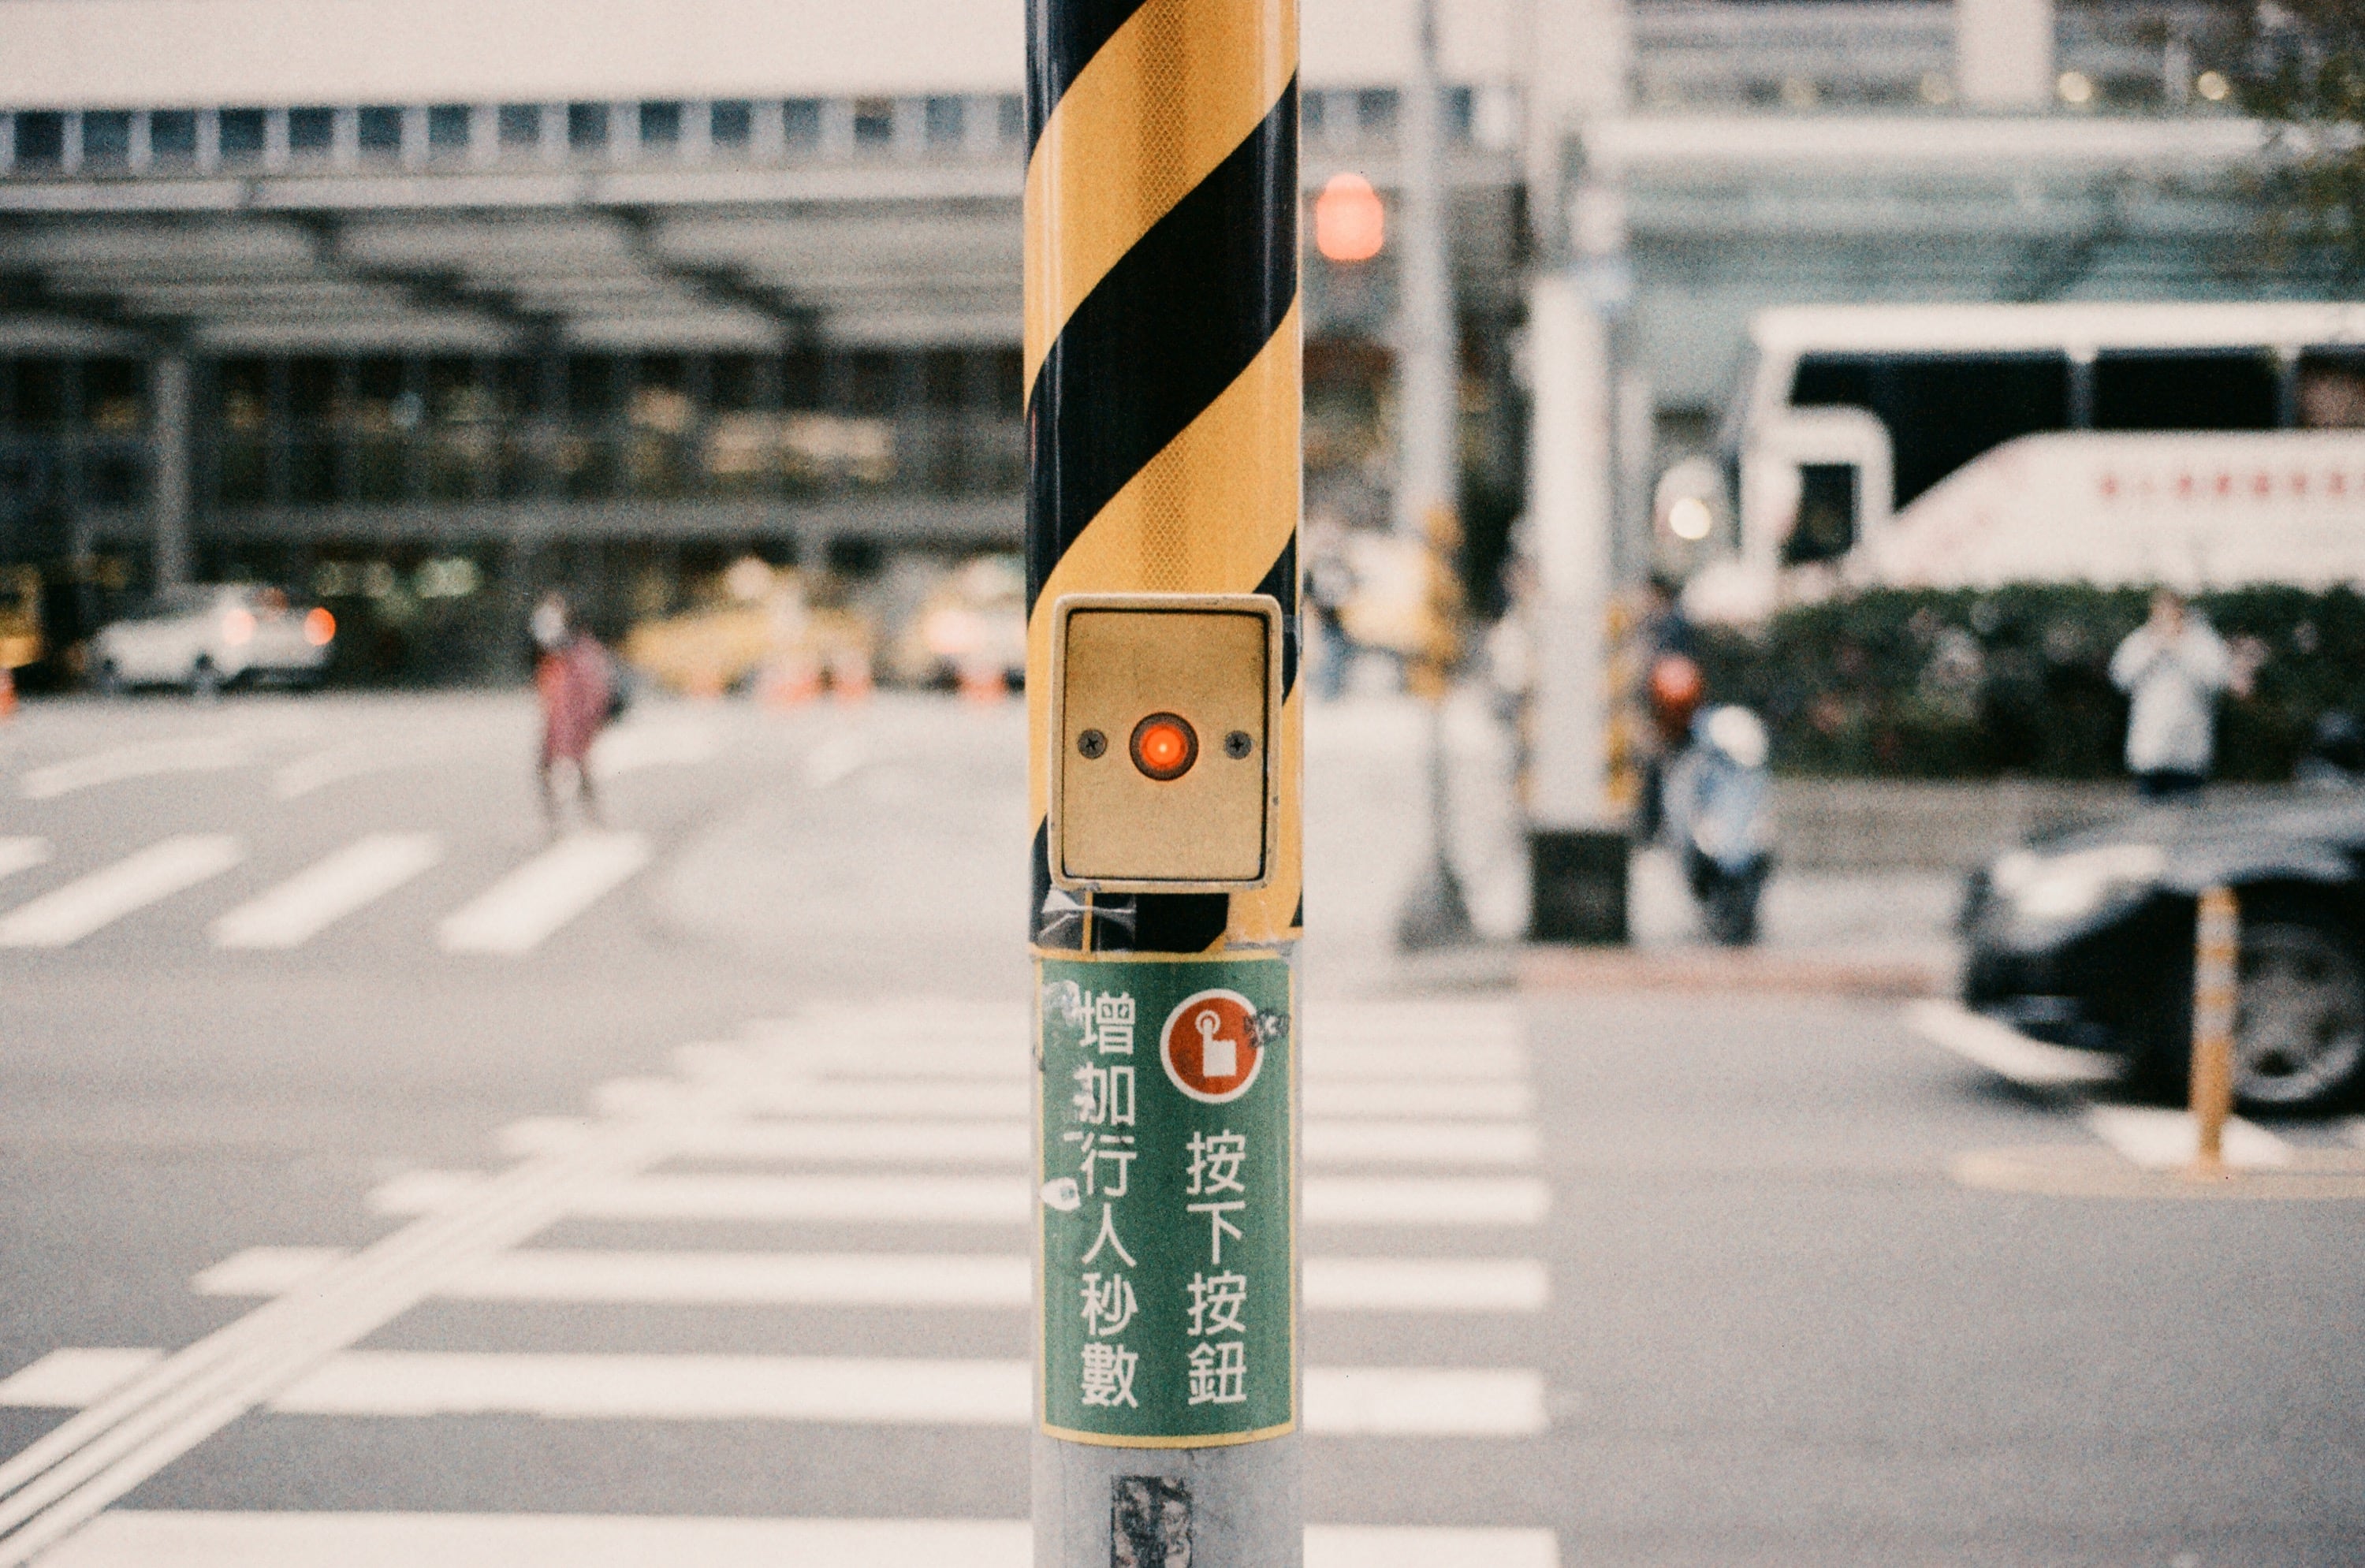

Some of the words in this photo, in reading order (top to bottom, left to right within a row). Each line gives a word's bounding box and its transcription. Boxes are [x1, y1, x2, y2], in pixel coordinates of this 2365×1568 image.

[1074, 991, 1138, 1409] 增加行人秒數
[1186, 1130, 1247, 1406] 按下按鈕
